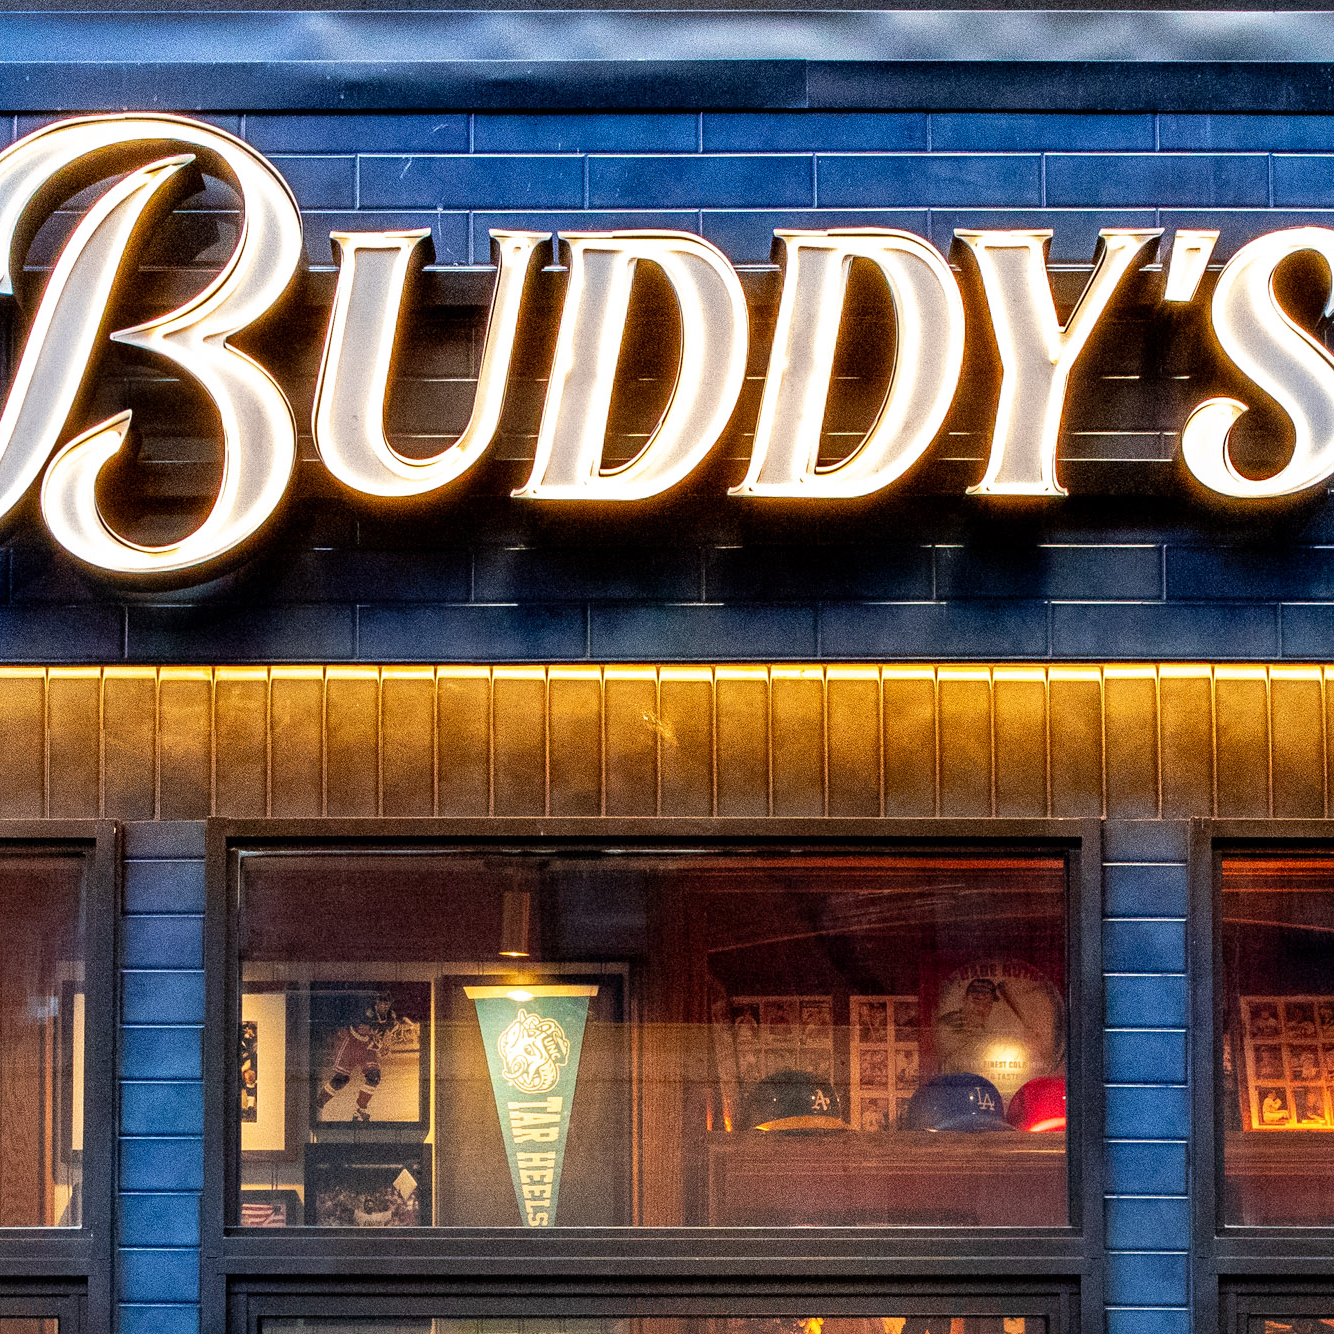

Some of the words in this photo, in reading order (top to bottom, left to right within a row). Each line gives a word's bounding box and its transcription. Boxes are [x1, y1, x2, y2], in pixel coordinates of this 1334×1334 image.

[544, 1036, 560, 1061] UNC
[974, 1086, 996, 1112] LA
[507, 1096, 564, 1145] TAR
[516, 1151, 557, 1228] HEELS
